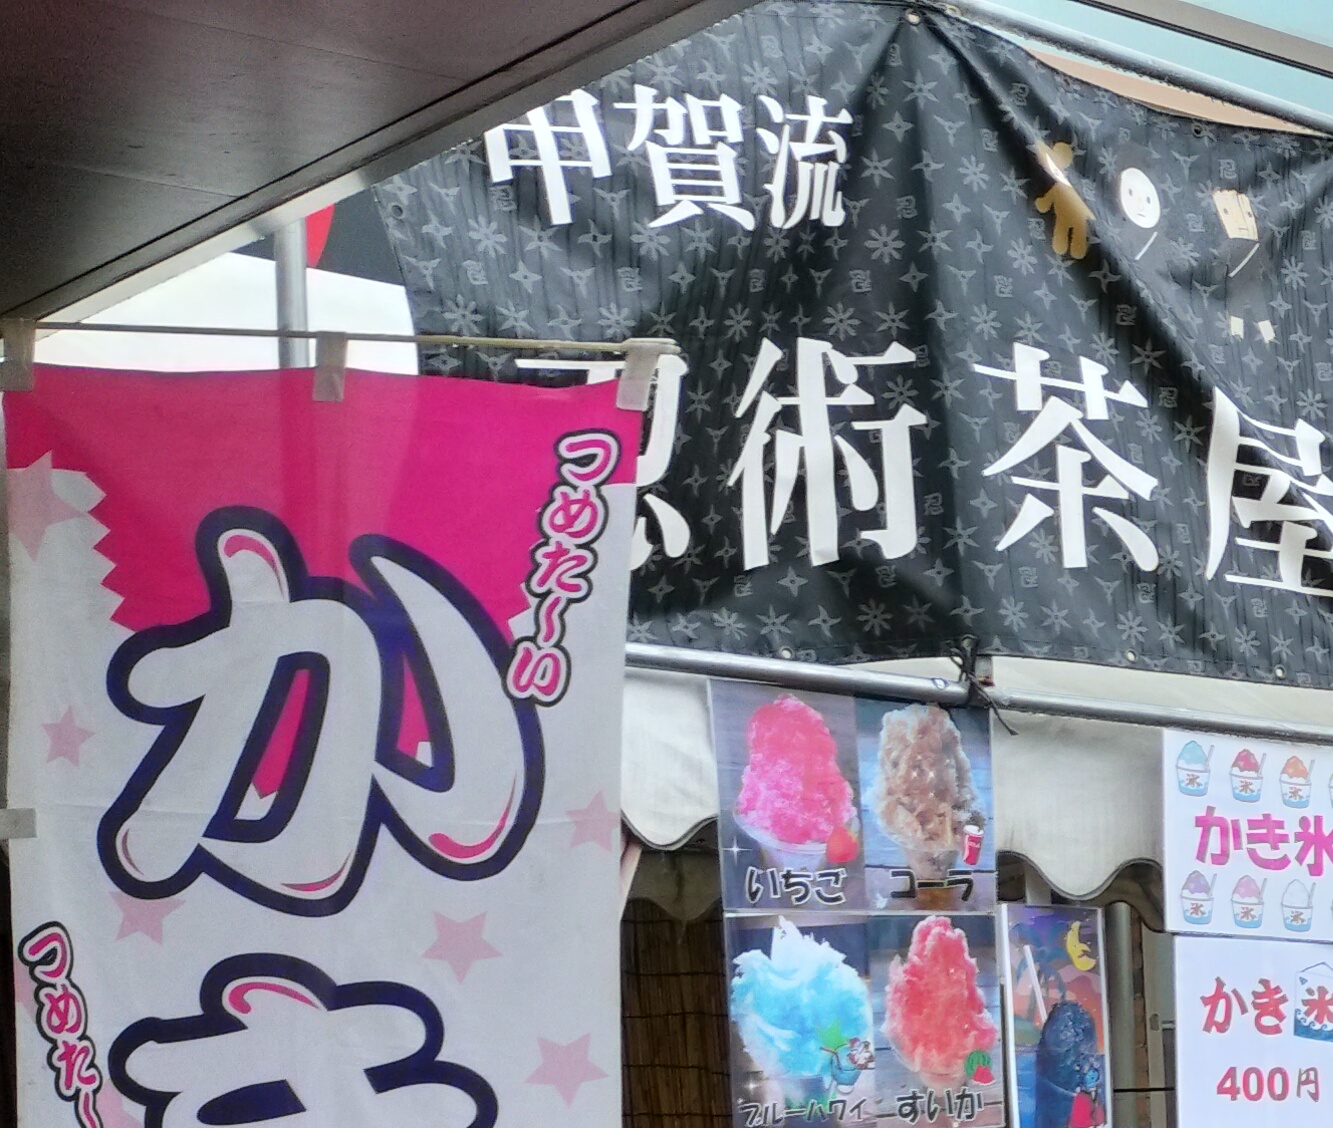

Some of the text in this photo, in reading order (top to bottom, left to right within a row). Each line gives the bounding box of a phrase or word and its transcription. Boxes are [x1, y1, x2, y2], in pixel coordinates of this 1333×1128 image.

[483, 84, 854, 231] 甲賀流
[745, 866, 848, 905] いちご
[889, 868, 975, 902] コーラ
[1215, 1065, 1320, 1103] 400円
[896, 1087, 984, 1125] すいか
